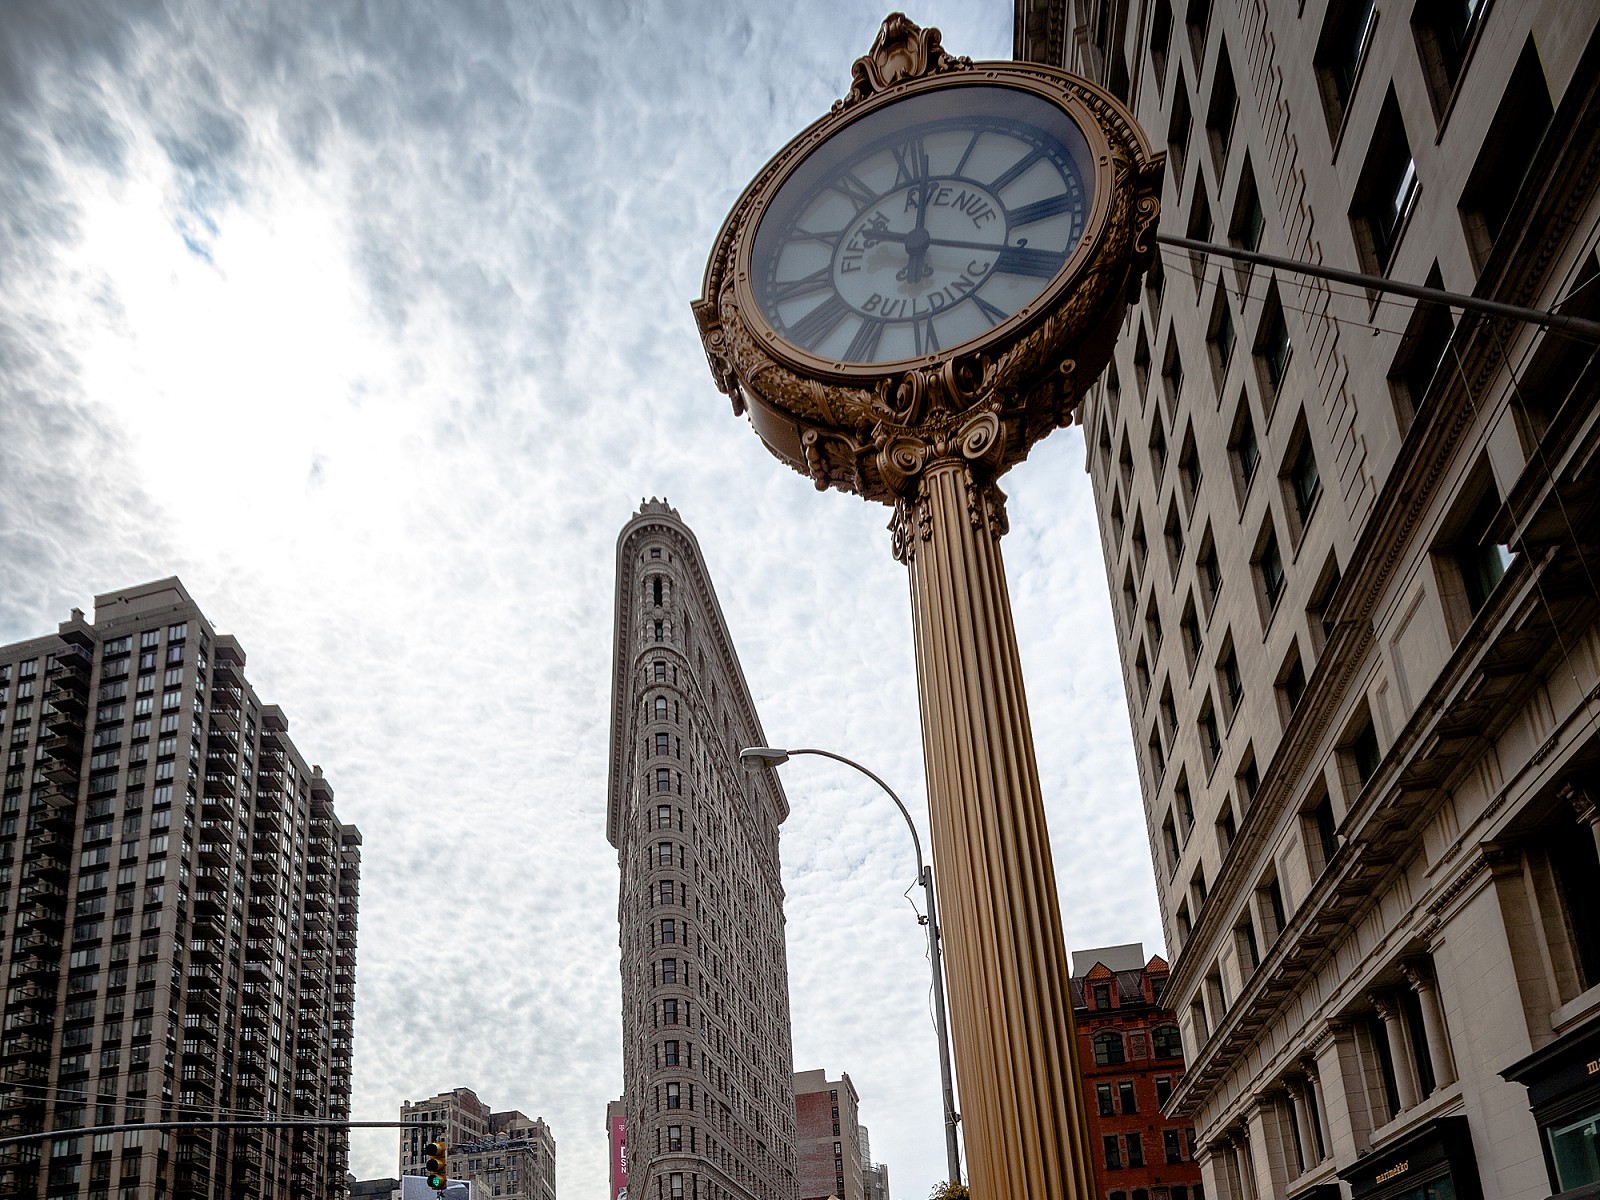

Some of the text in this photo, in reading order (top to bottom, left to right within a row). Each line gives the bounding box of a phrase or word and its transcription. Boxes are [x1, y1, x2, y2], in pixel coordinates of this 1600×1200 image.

[841, 186, 997, 274] FIFTH AVENUE
[861, 259, 990, 317] BUILDING
[1375, 1162, 1409, 1184] marimekko
